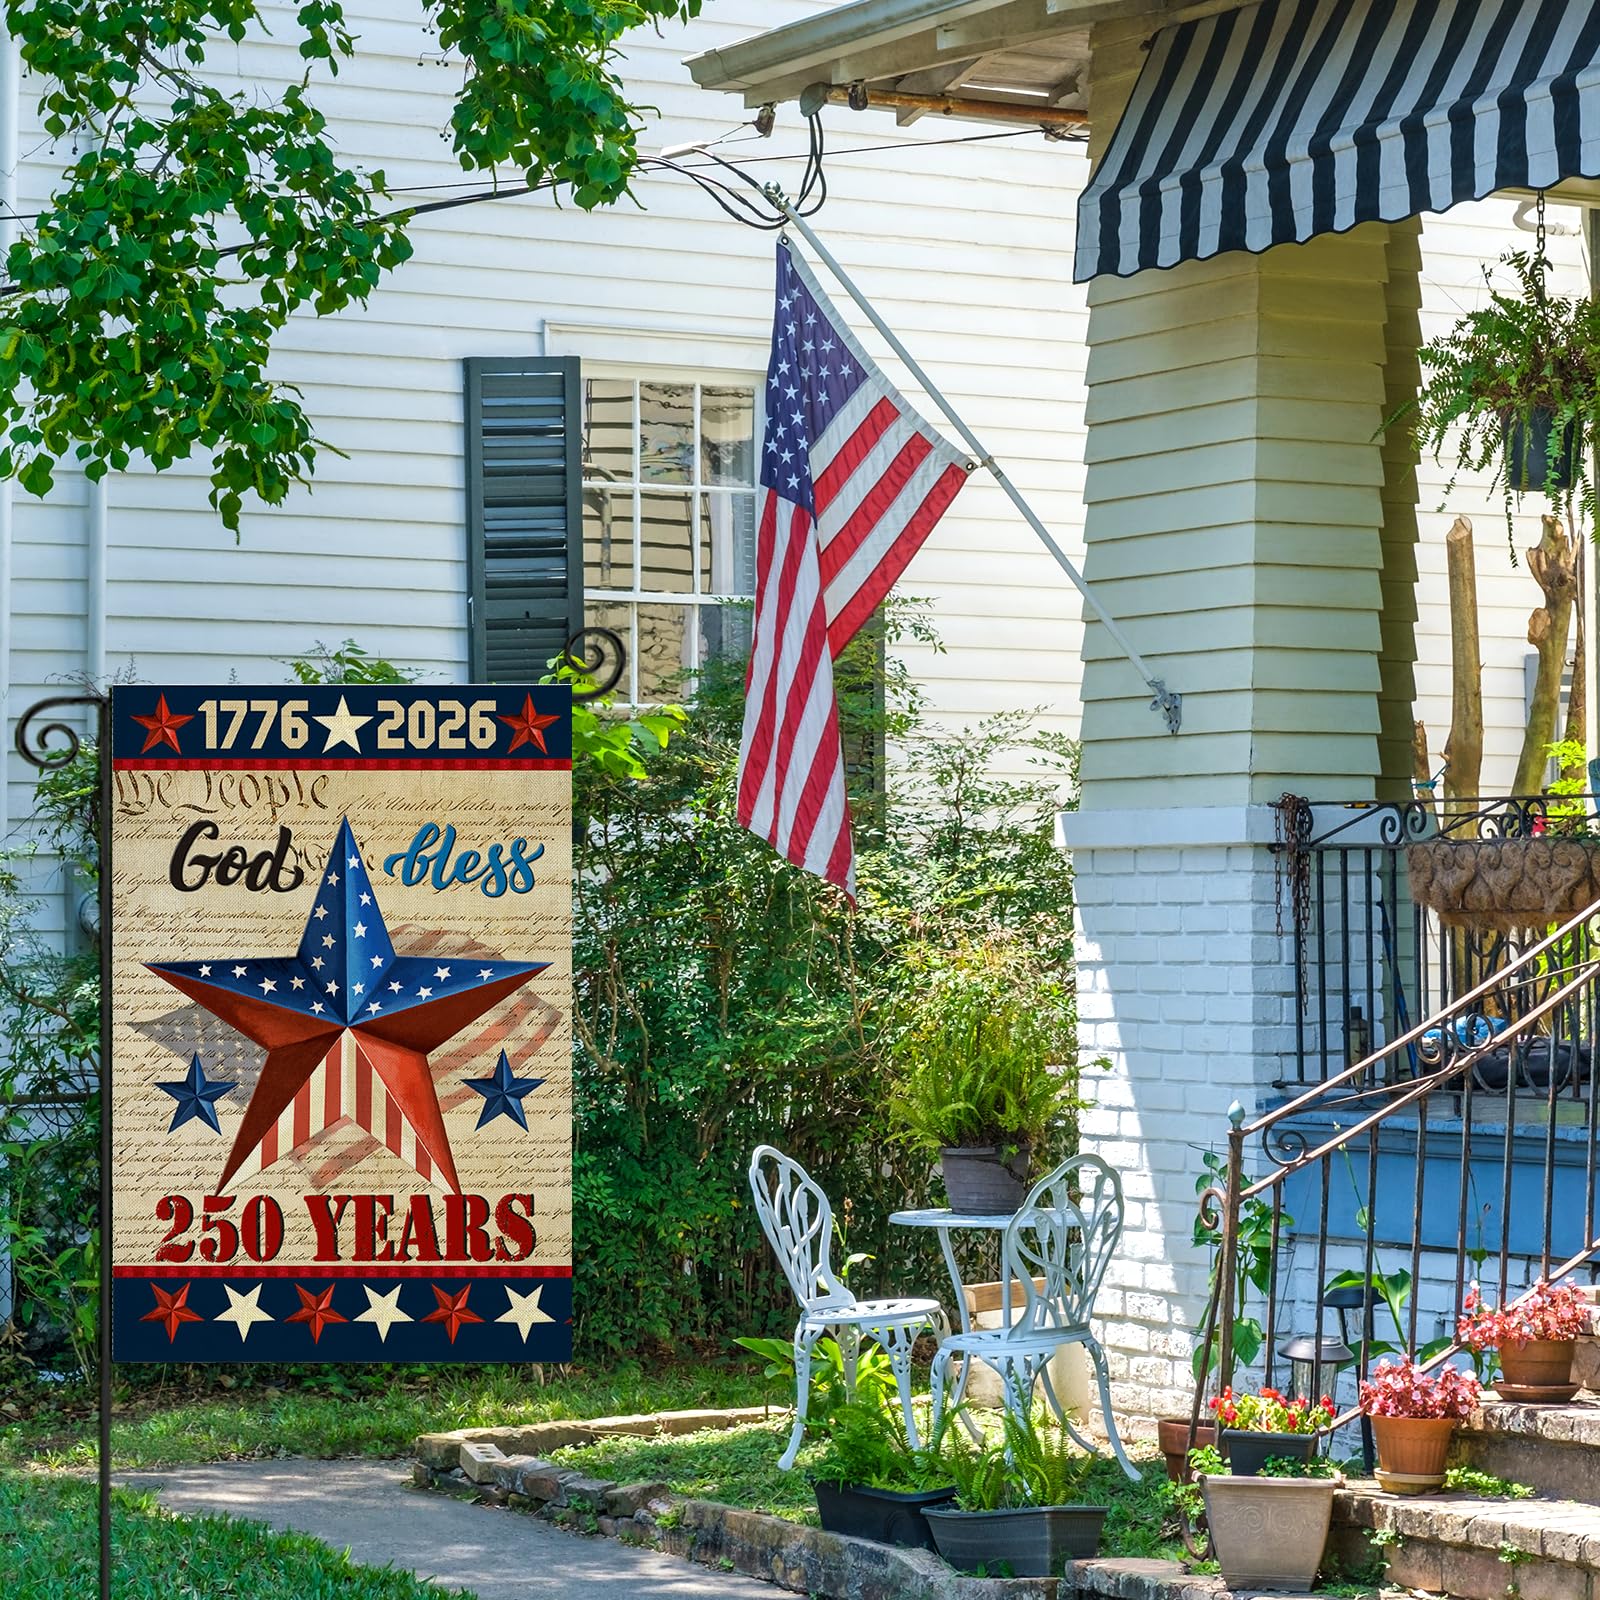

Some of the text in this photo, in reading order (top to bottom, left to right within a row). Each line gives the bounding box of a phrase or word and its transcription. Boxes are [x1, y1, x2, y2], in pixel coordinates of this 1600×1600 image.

[198, 700, 497, 750] 1776 2026
[385, 797, 444, 812] United
[169, 820, 544, 898] God bless
[155, 1194, 536, 1262] 250 YEARS
